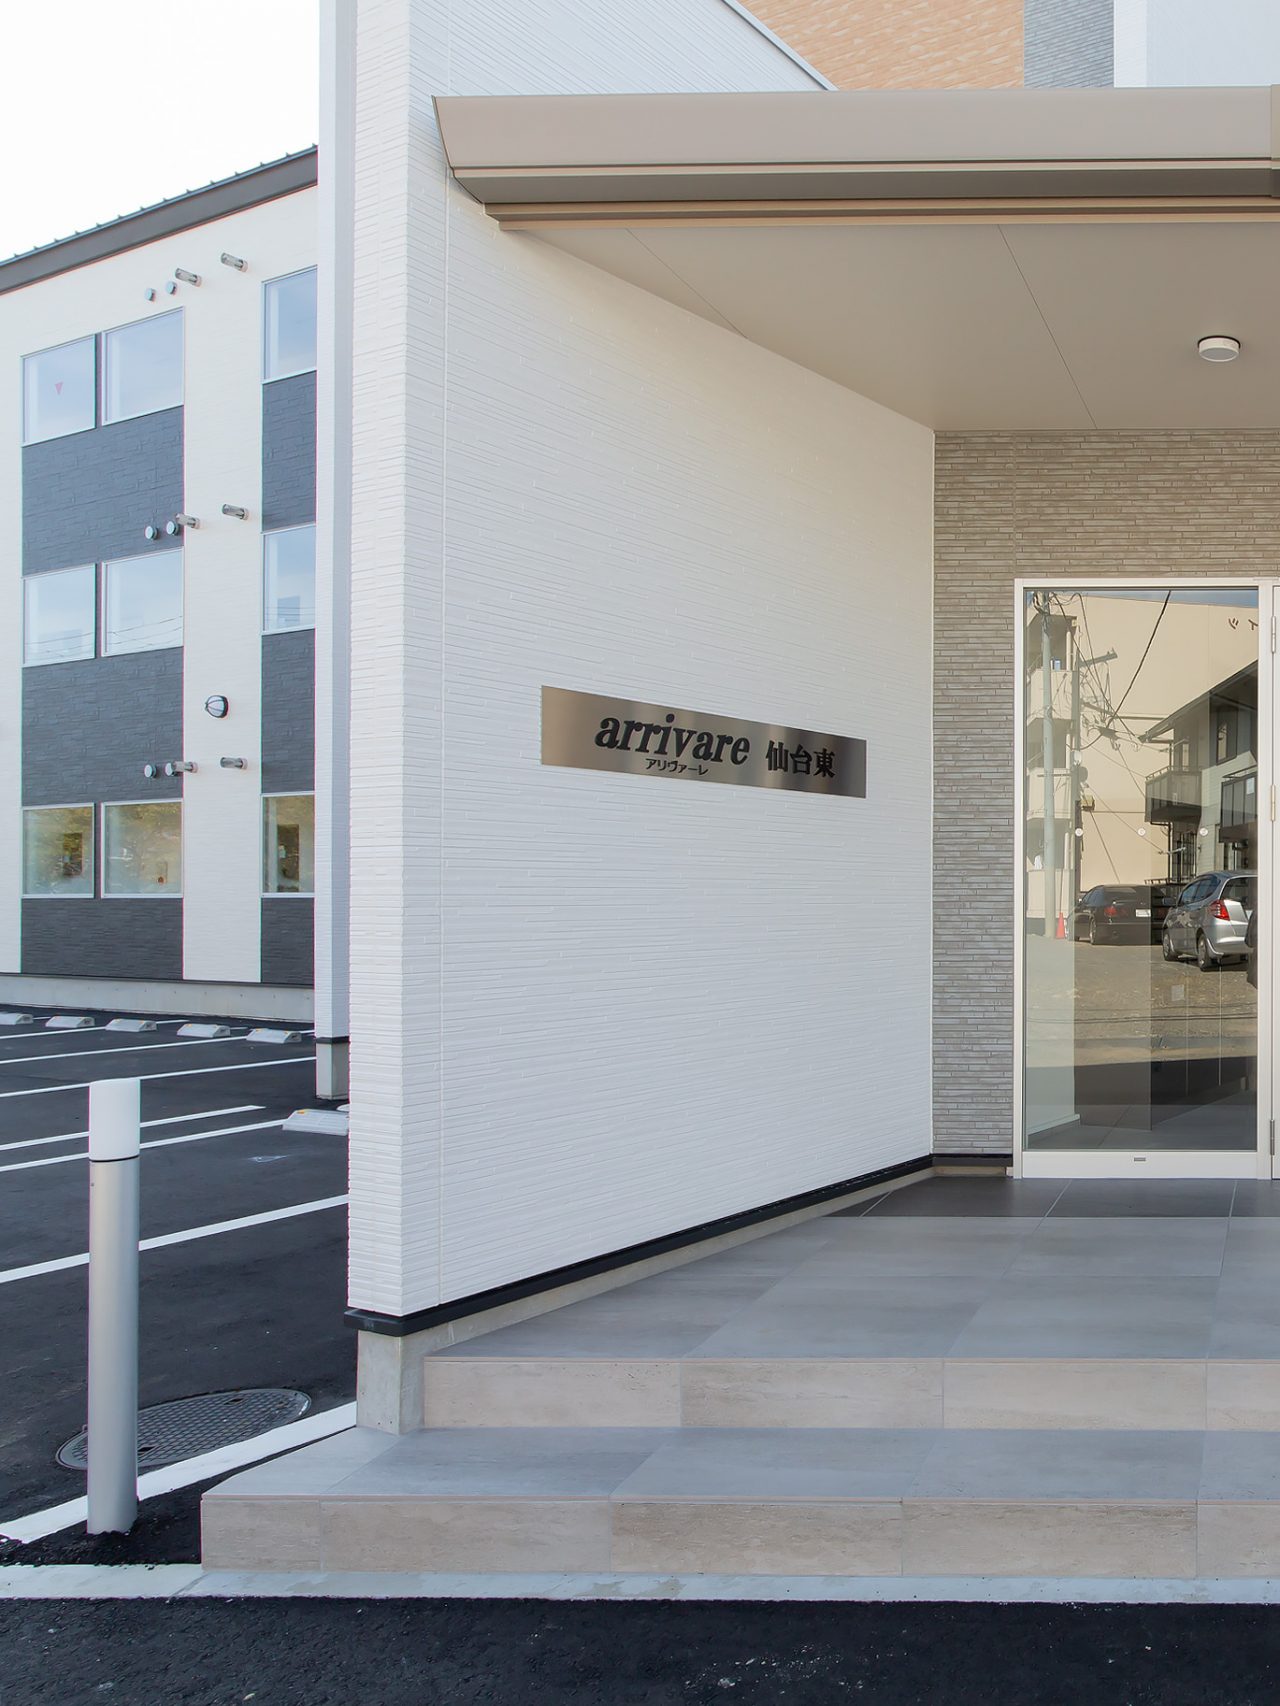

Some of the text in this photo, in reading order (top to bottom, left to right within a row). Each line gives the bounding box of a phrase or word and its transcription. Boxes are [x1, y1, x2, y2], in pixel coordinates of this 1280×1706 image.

[594, 713, 836, 778] arrivare 仙台東
[645, 758, 709, 776] アリヴァーレ
